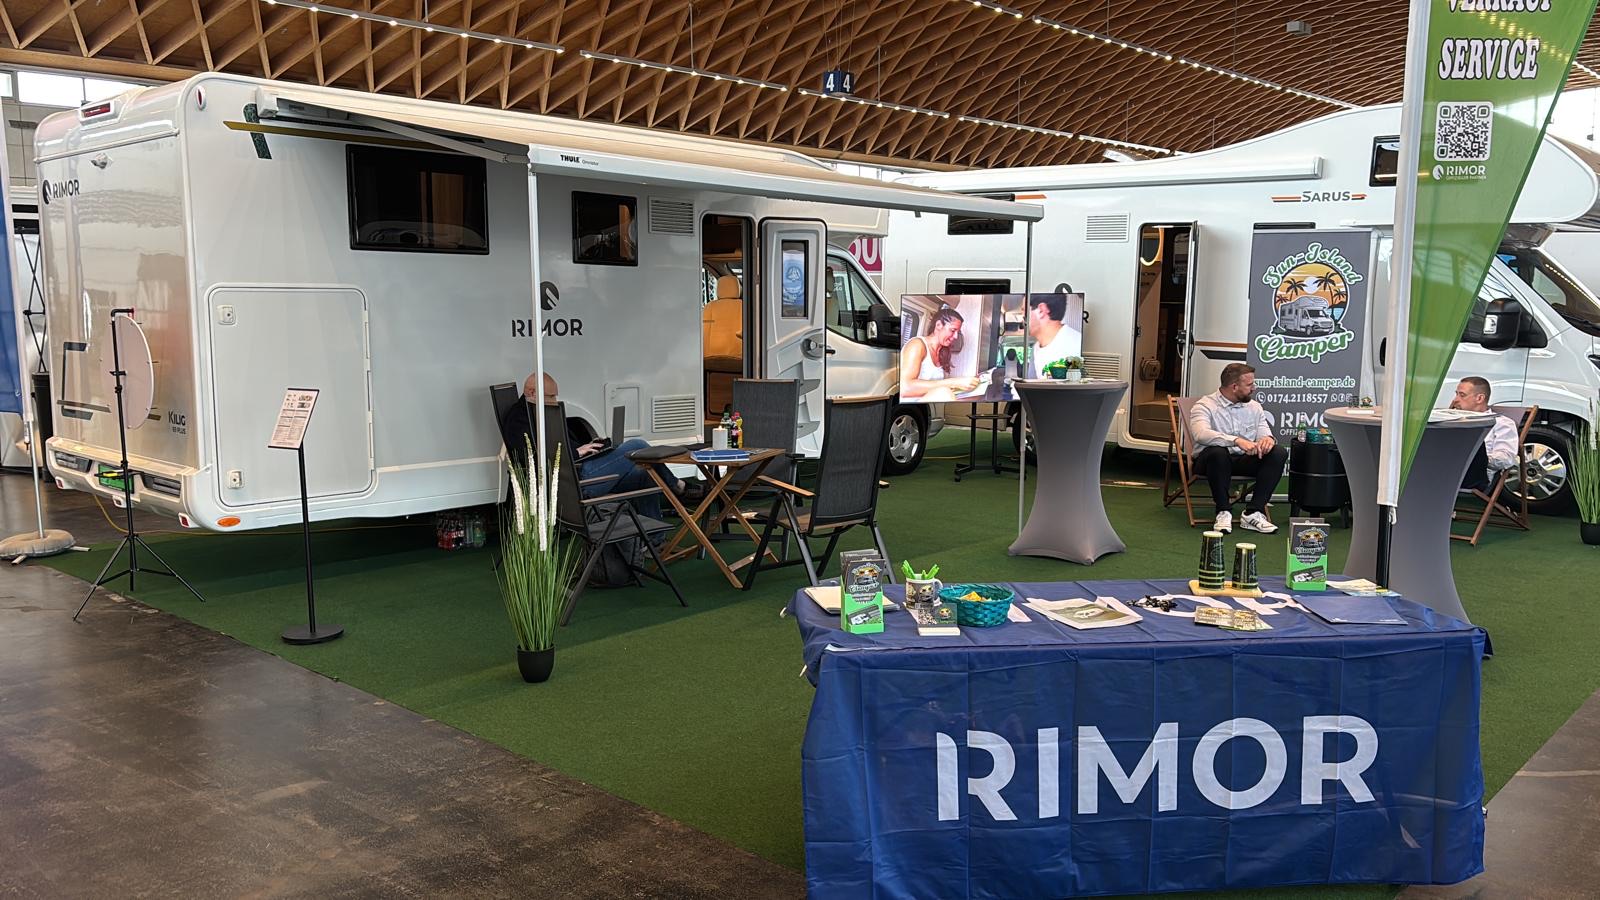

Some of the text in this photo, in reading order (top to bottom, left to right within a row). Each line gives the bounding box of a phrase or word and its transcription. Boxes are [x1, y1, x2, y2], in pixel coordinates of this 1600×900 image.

[1438, 38, 1540, 80] SERVICE
[826, 73, 835, 92] 4
[843, 73, 850, 92] 4
[560, 154, 580, 163] THULE
[1446, 165, 1486, 175] RIMOR
[52, 179, 80, 199] RIMOR
[1302, 191, 1351, 202] SARUS
[1262, 242, 1363, 287] Sun-Island
[1254, 330, 1355, 364] Camper
[1254, 375, 1356, 390] sun-island-camper.de
[1266, 393, 1329, 404] 0174.2118557
[1280, 411, 1329, 428] RIM
[936, 715, 1379, 821] RIMOR
